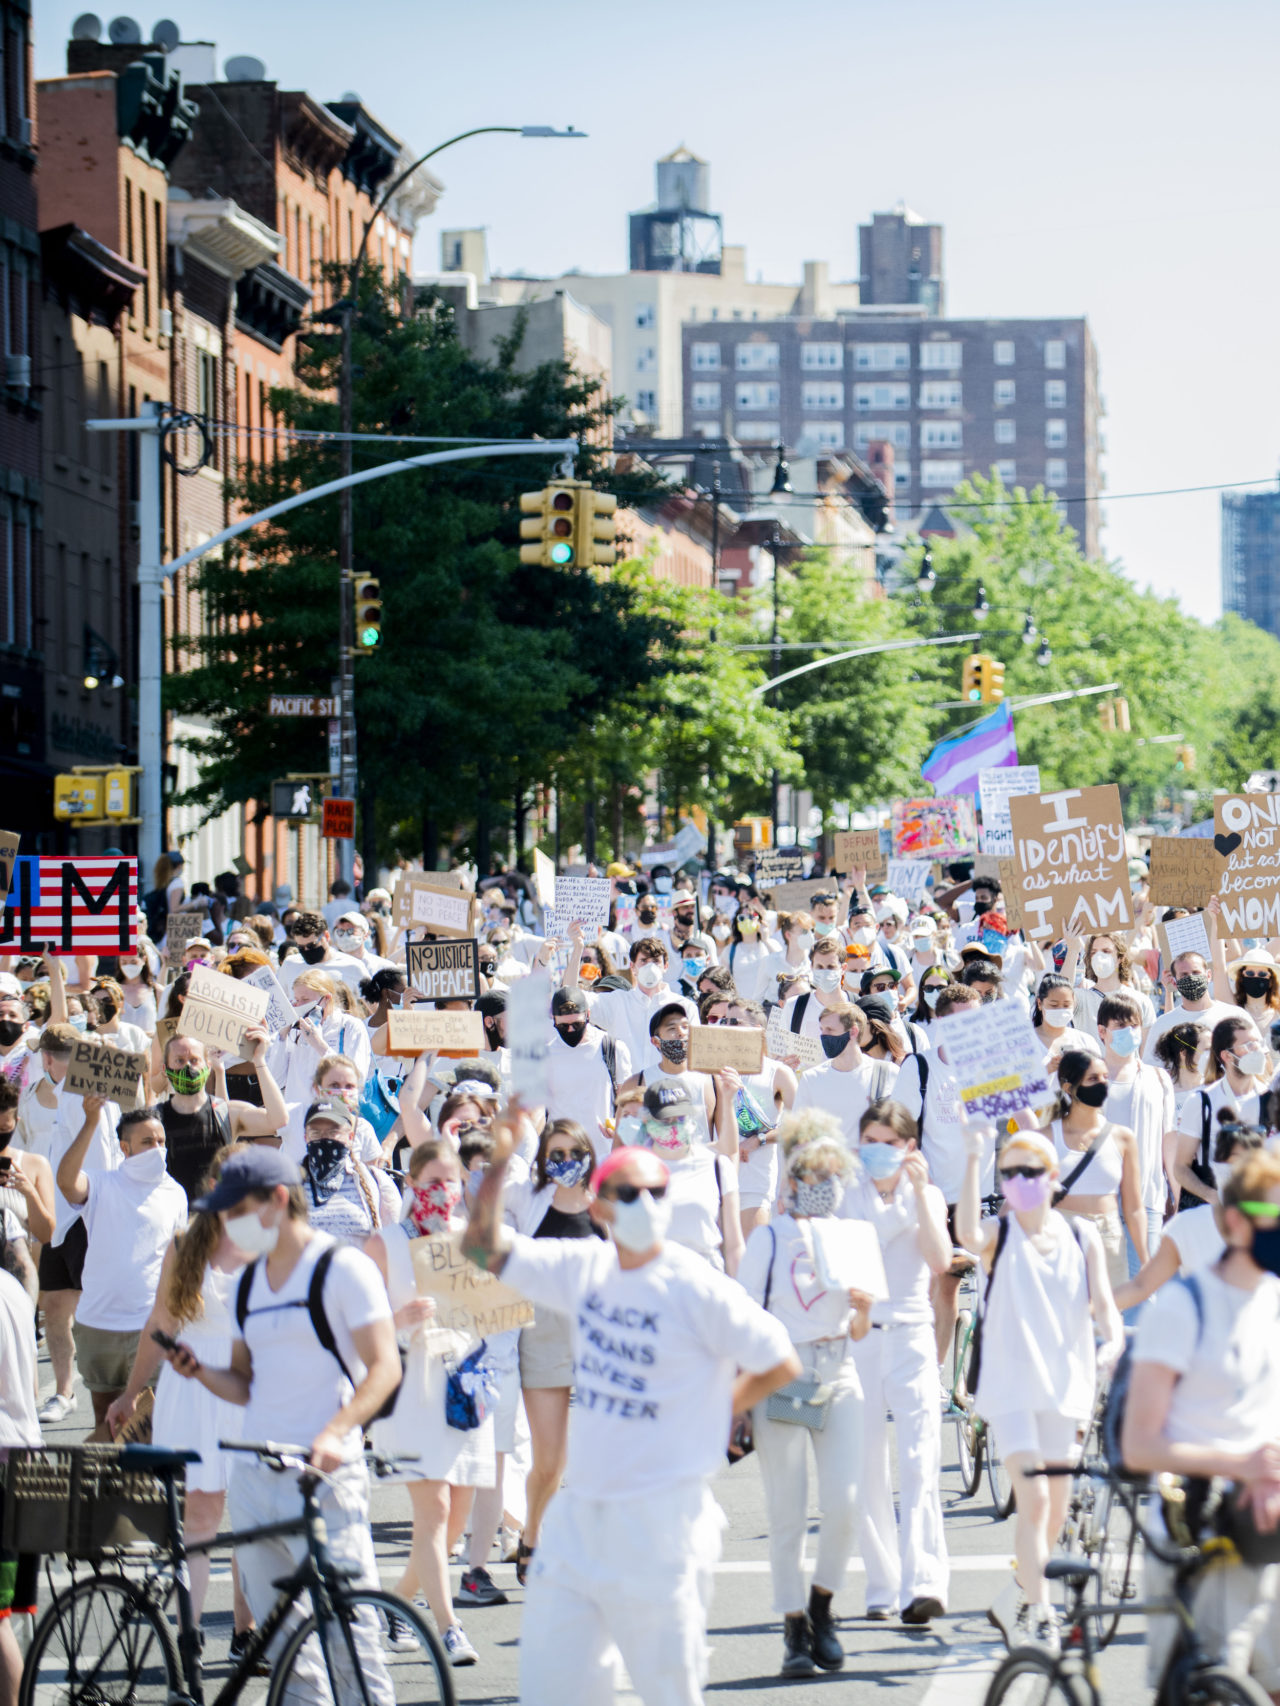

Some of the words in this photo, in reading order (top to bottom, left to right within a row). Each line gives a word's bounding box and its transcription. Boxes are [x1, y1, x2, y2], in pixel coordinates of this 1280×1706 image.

[269, 697, 315, 715] PACIFIC
[319, 697, 332, 715] ST
[1040, 789, 1088, 833] I
[985, 829, 1012, 841] FIGHT
[1243, 826, 1278, 849] NOT
[843, 850, 879, 863] POLICE
[1227, 849, 1255, 871] but
[1022, 872, 1051, 891] as
[1048, 862, 1113, 885] what
[417, 906, 433, 918] NO
[438, 910, 463, 923] PEACE
[418, 894, 433, 906] NO
[436, 896, 468, 914] JUSTICE
[1024, 895, 1054, 939] I
[1067, 886, 1130, 928] AM
[428, 944, 473, 971] JUSTICE
[411, 970, 431, 996] NO
[431, 969, 475, 997] PEACE
[189, 981, 261, 1018] ABOLISH
[184, 1007, 246, 1047] POLICE
[70, 1074, 107, 1093] LIVES
[89, 1062, 142, 1083] TRANS
[964, 1094, 1003, 1115] BLACK
[1003, 1079, 1048, 1101] TRANS
[984, 1099, 1031, 1119] WOMEN
[585, 1290, 660, 1334] BLACK
